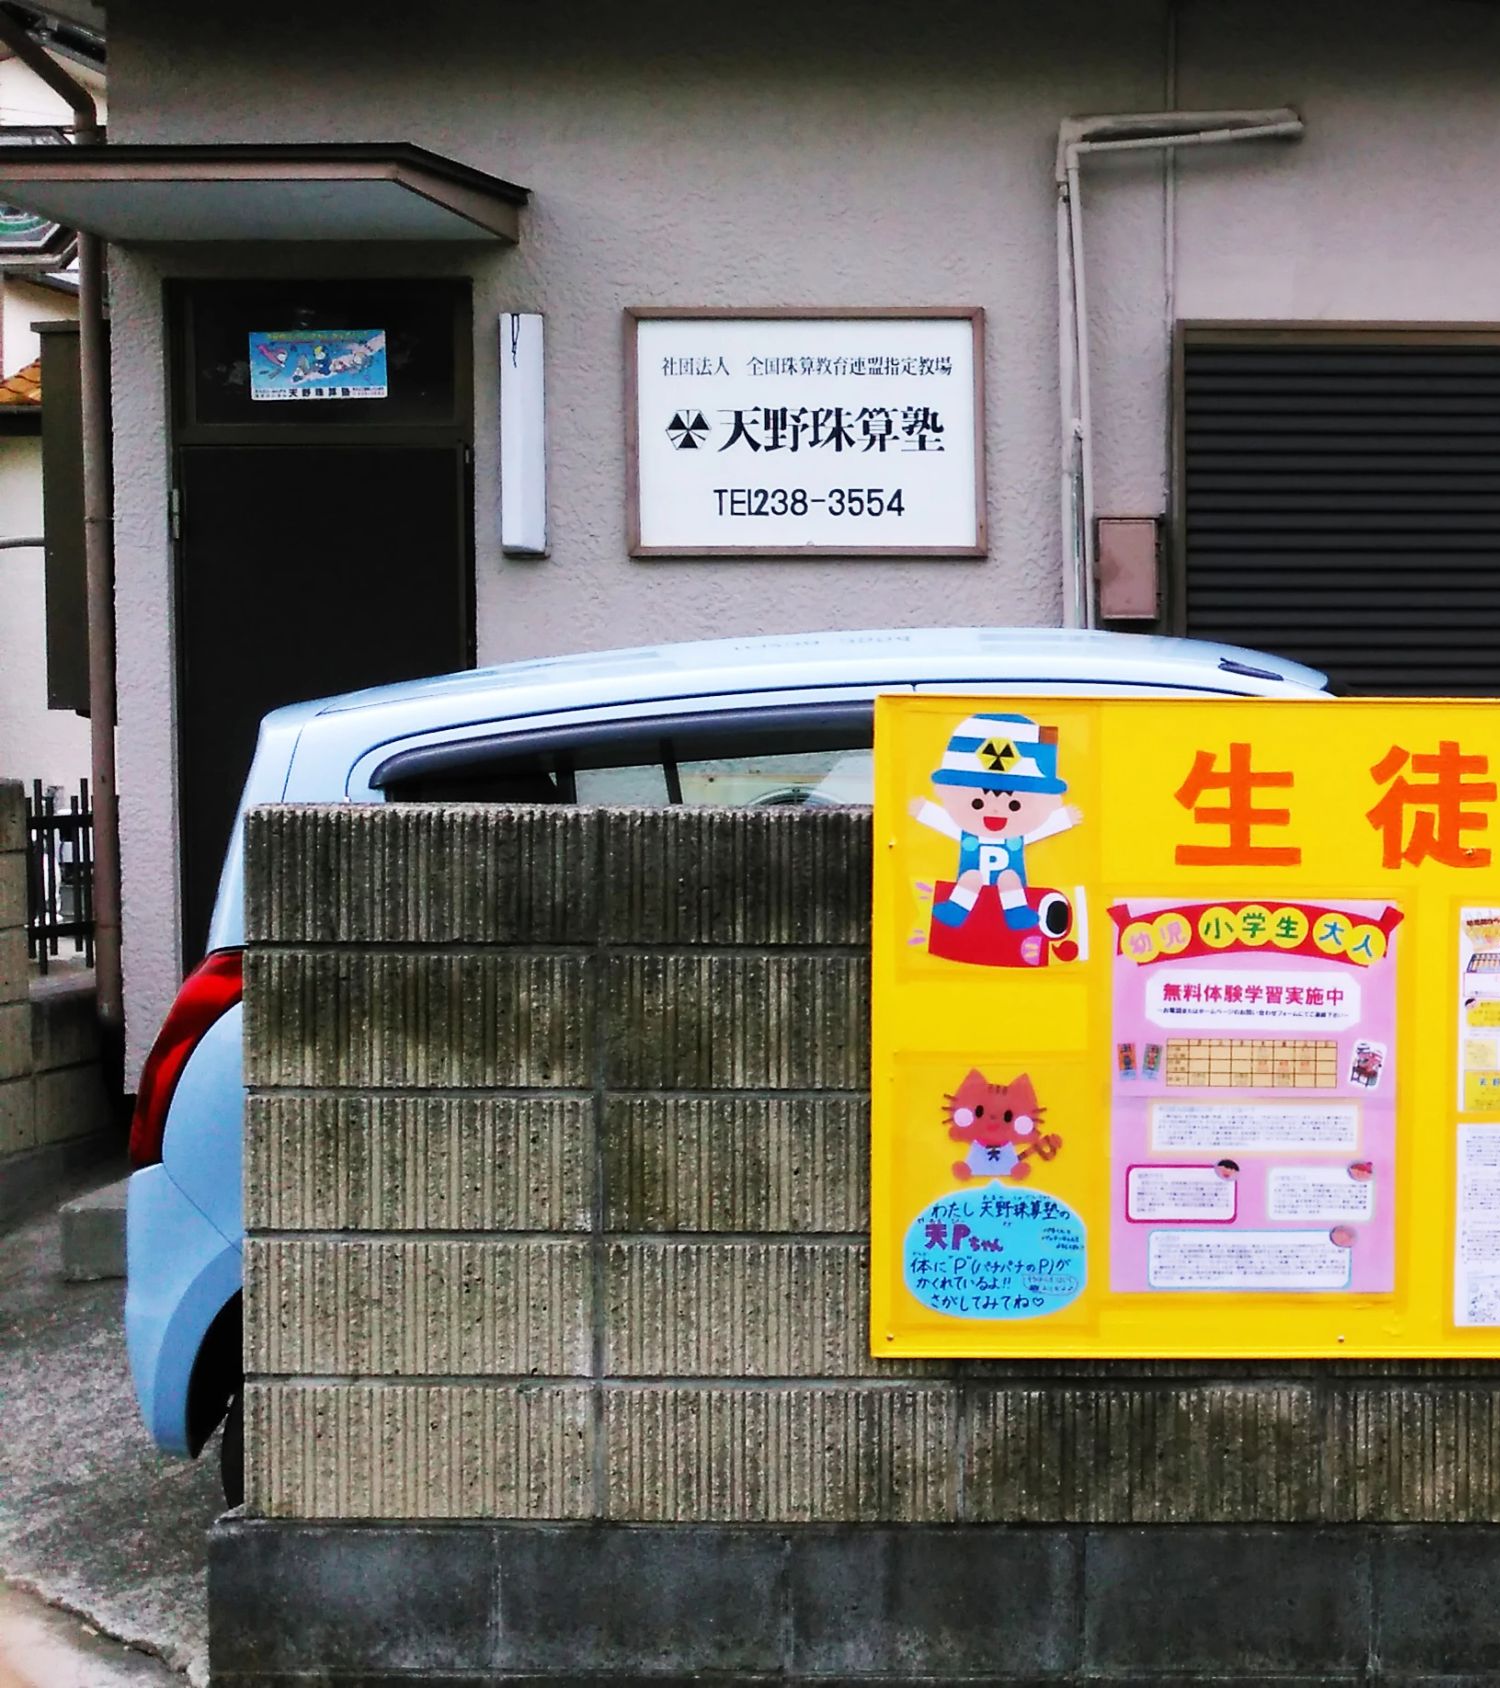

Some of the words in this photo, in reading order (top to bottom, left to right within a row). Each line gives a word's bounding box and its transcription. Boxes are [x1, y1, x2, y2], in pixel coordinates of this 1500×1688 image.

[661, 356, 731, 377] 社団法人
[745, 355, 953, 377] 全国珠算教育連盟指定教場
[716, 405, 946, 453] 天野珠算塾
[978, 844, 1011, 886] P
[1202, 911, 1300, 941] 小学生
[1319, 921, 1374, 958] 大人
[1162, 983, 1345, 1007] 無料体験学習実施中
[931, 1202, 975, 1219] わたし
[979, 1200, 1071, 1220] 天野珠算塾の
[915, 1276, 1012, 1290] かくれているよ!!
